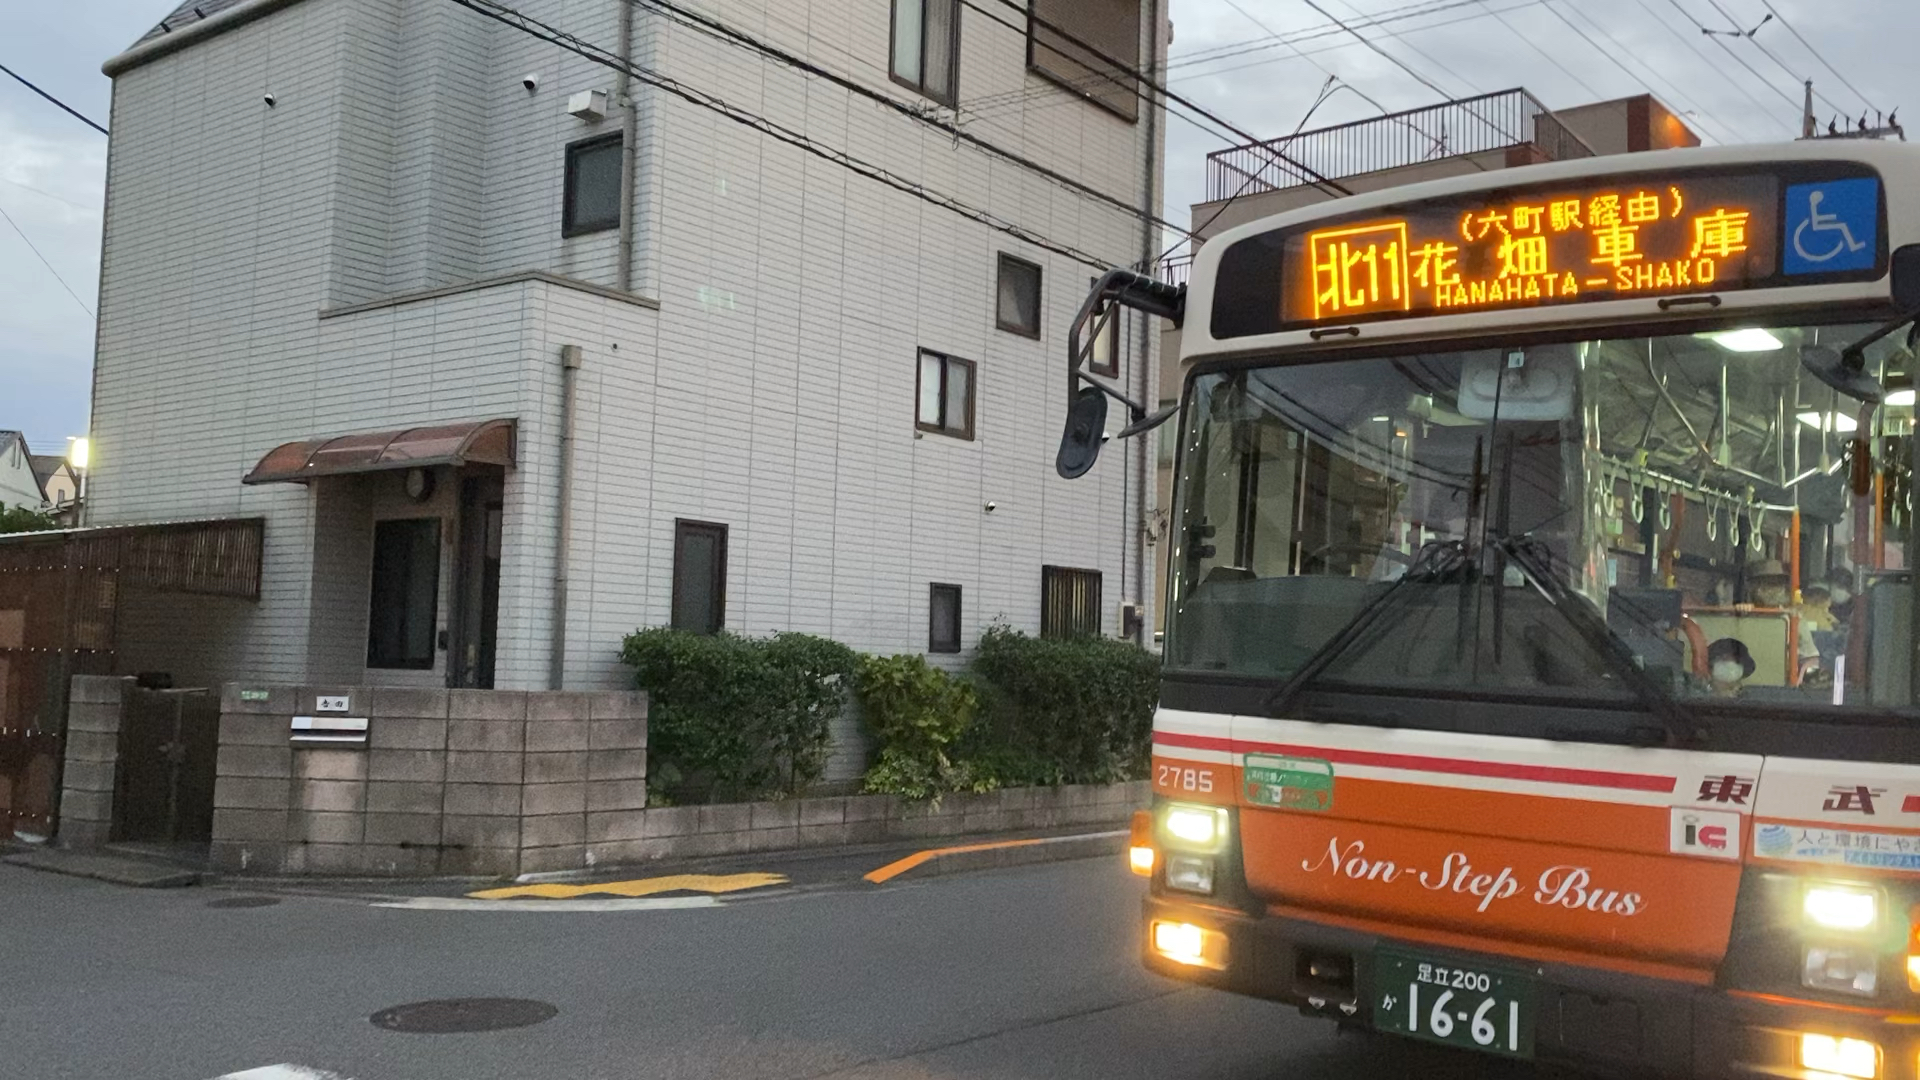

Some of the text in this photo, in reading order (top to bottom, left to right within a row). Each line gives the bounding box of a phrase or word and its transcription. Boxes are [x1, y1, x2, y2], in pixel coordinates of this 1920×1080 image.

[1462, 187, 1683, 242] (六町駅経由)
[1158, 764, 1213, 793] 2785
[1302, 837, 1649, 916] Non-Step Bus
[1409, 982, 1519, 1051] 16-61
